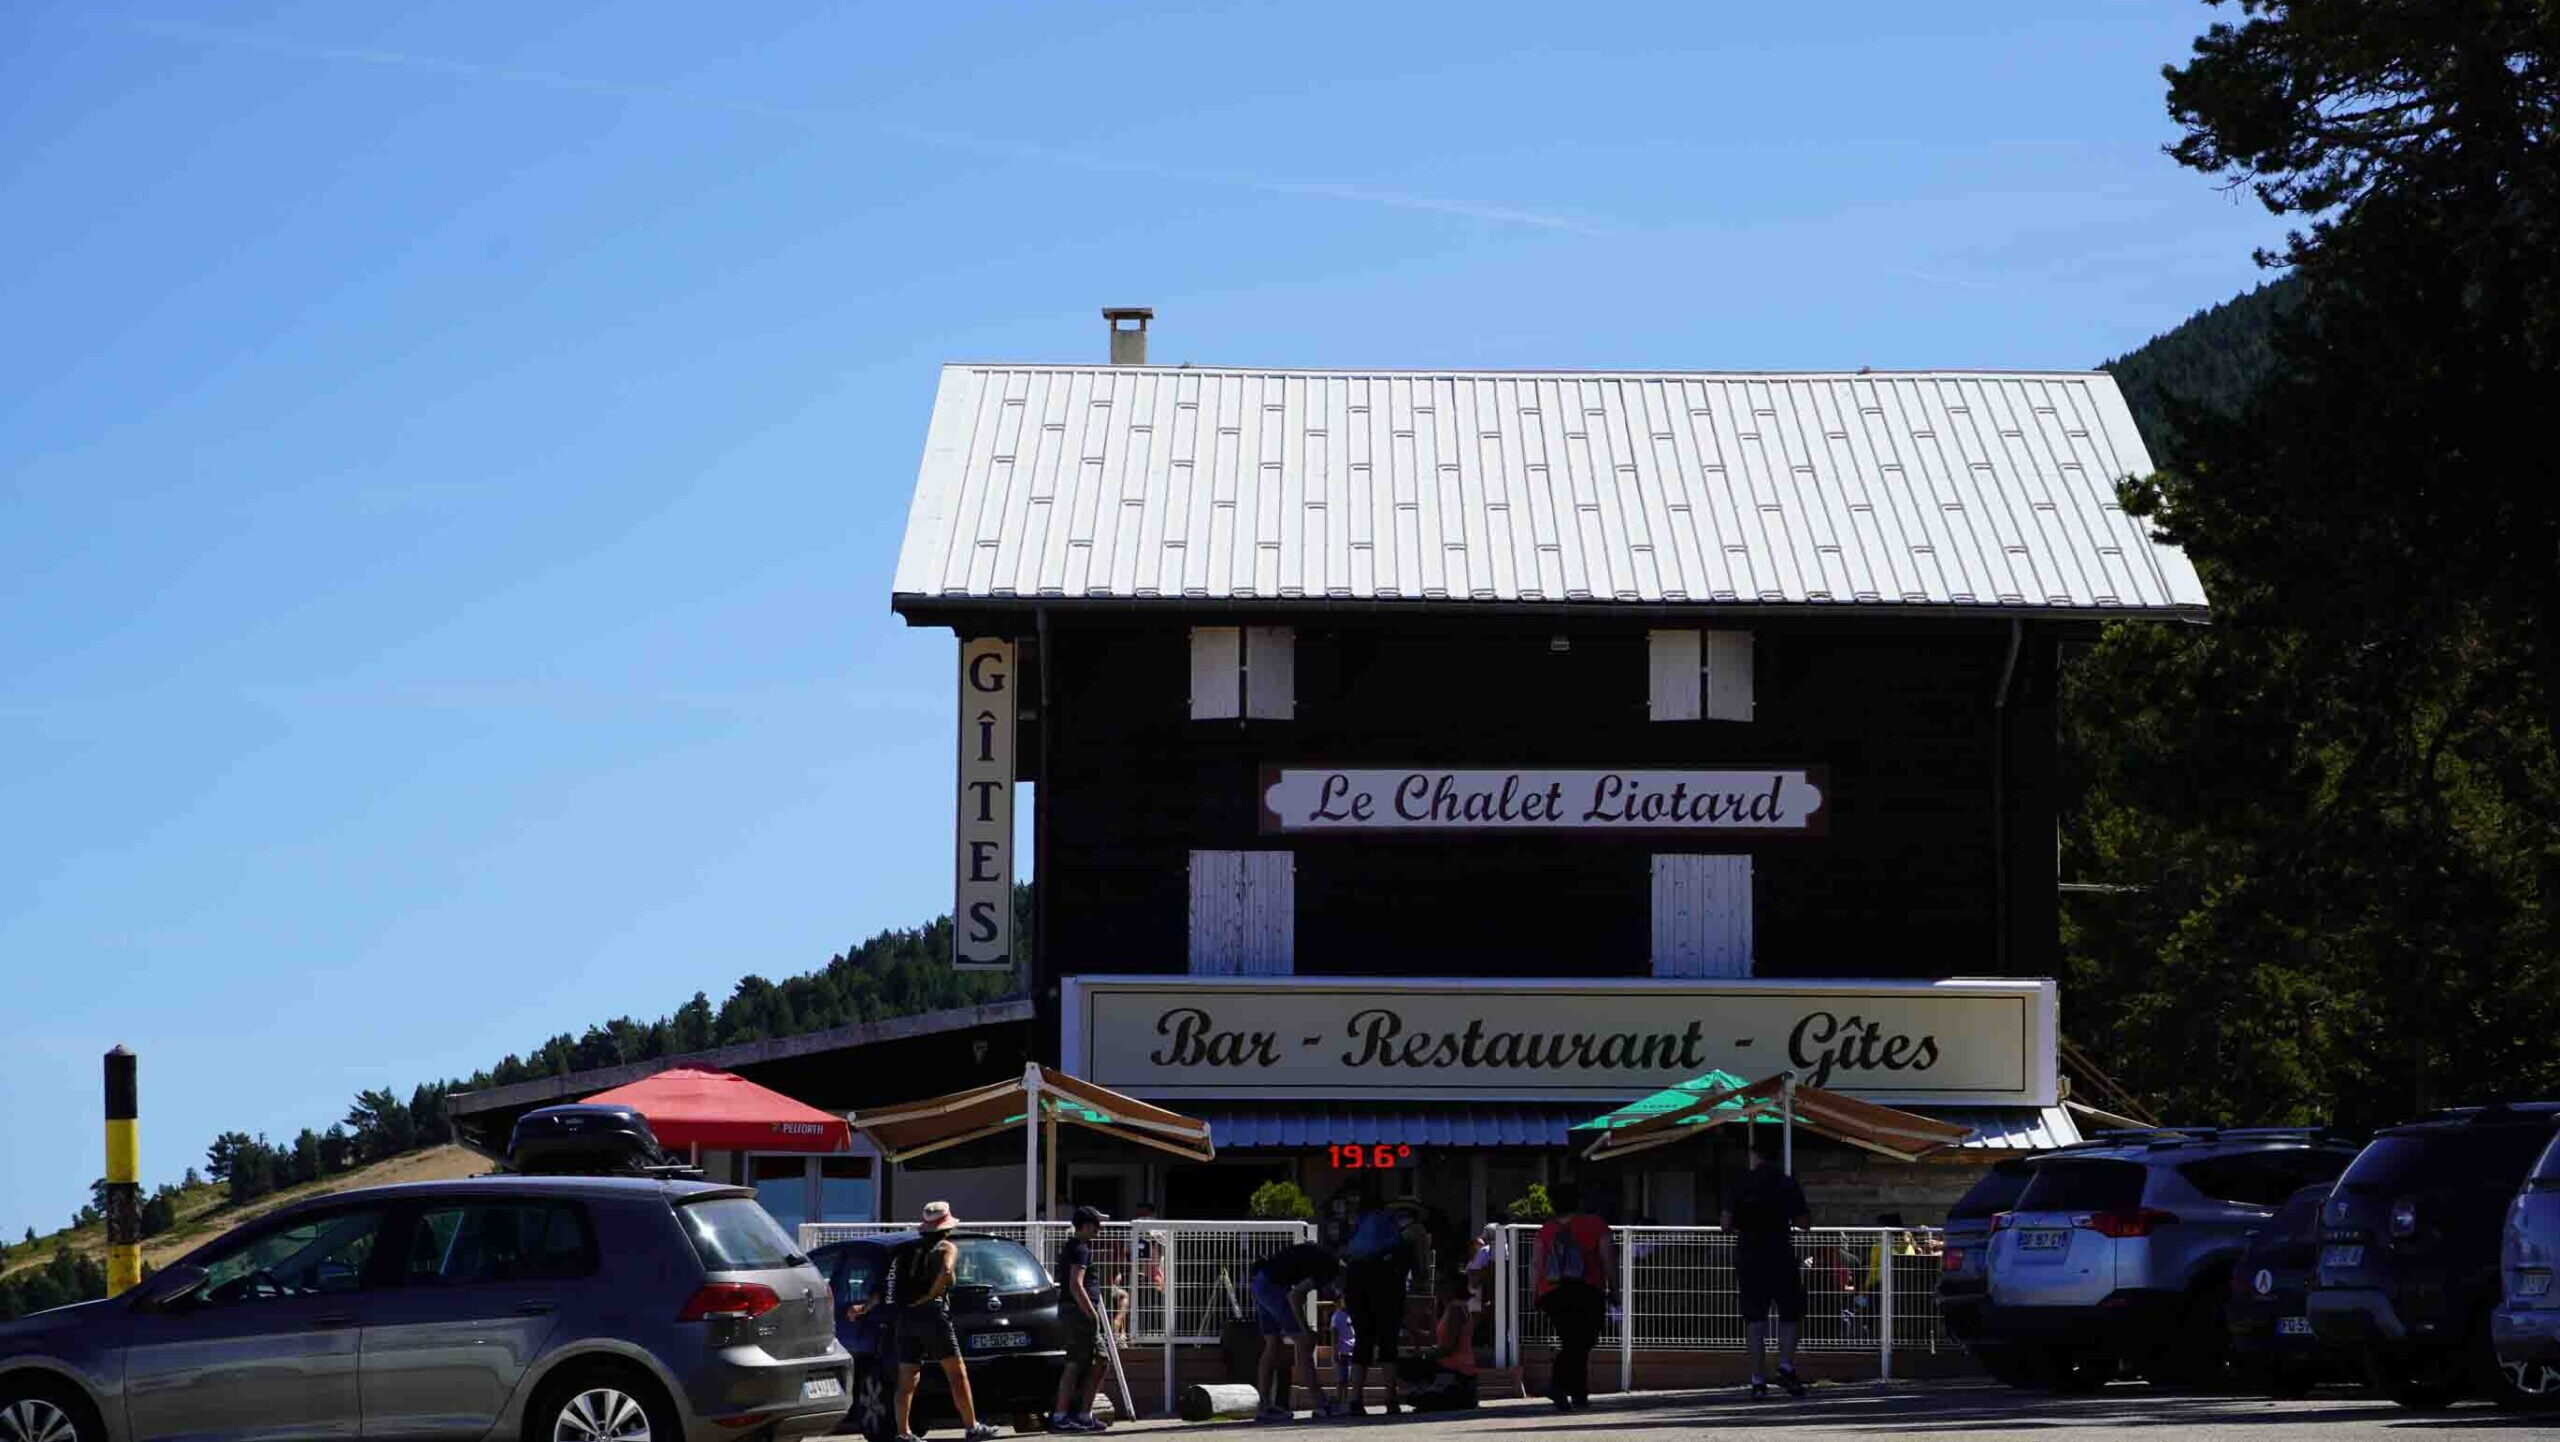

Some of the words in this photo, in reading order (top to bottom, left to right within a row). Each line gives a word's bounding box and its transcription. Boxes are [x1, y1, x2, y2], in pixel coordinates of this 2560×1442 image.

[967, 652, 1006, 945] GÎTES
[1309, 774, 1375, 822] Le
[1394, 773, 1564, 822] Chalet
[1582, 773, 1785, 824] Liotard
[1151, 1008, 1281, 1067] Bar
[1302, 1034, 1322, 1047] -
[1341, 1009, 1706, 1069] Restaurant
[1735, 1036, 1755, 1048] -
[1788, 1011, 1938, 1088] Gîtes
[1328, 1143, 1412, 1169] 19.6°
